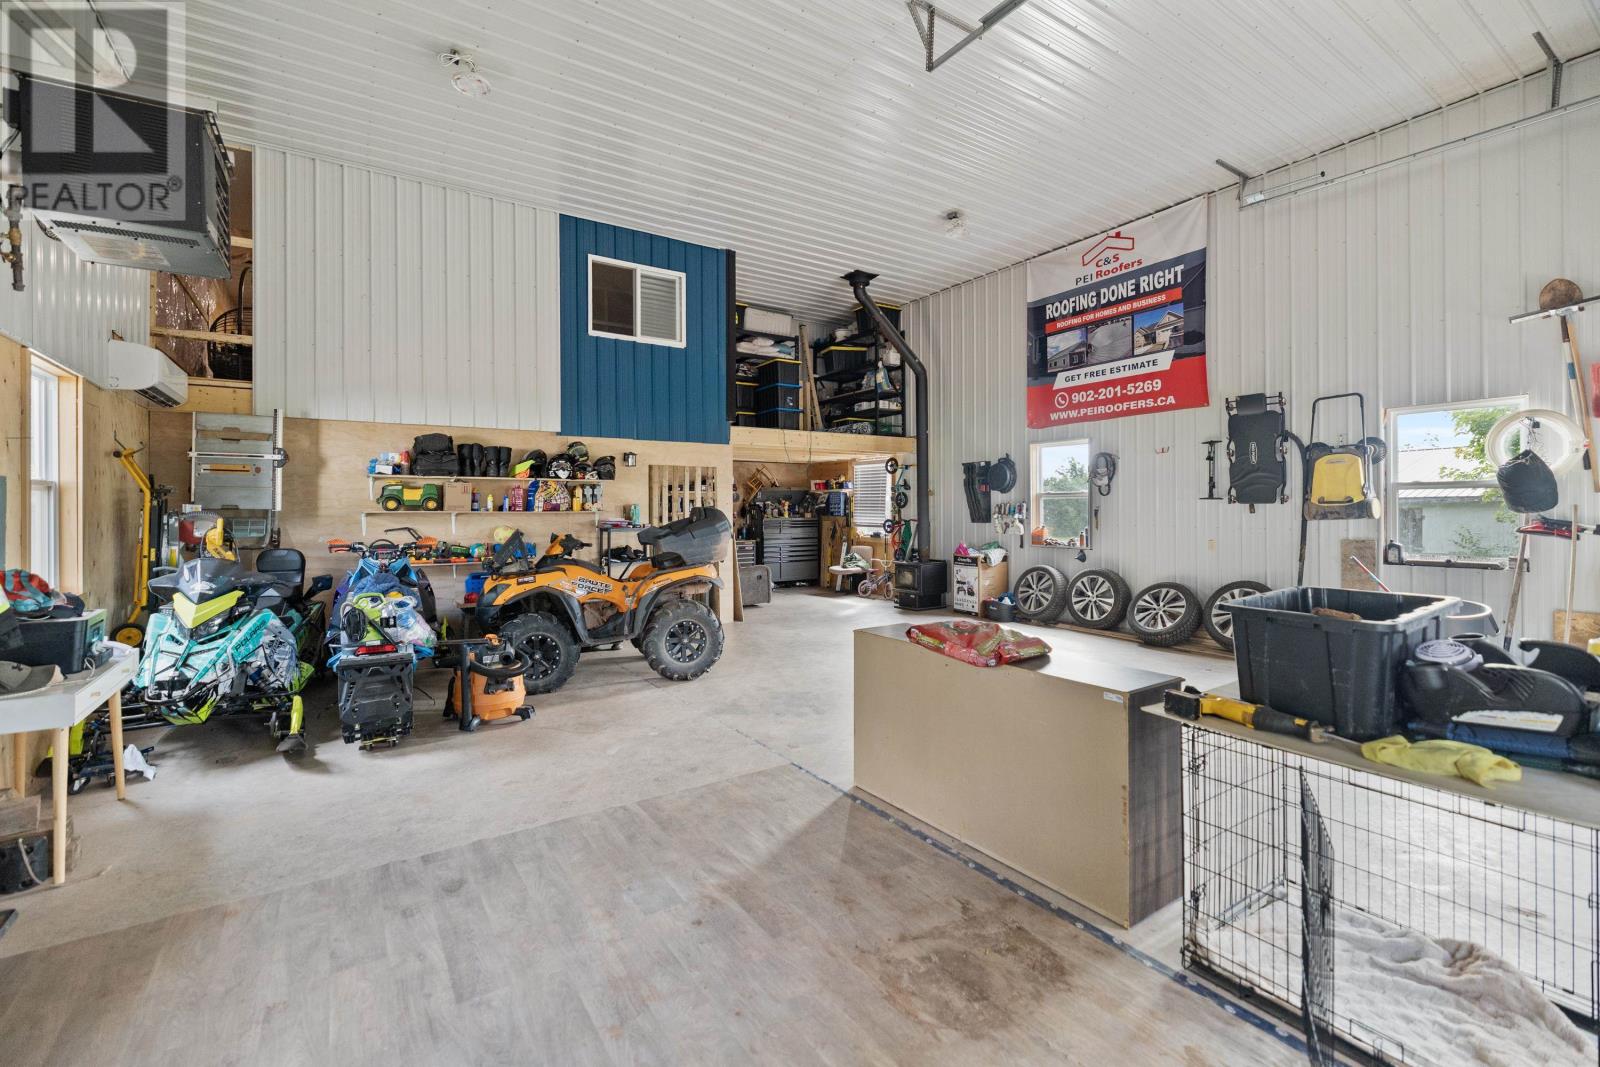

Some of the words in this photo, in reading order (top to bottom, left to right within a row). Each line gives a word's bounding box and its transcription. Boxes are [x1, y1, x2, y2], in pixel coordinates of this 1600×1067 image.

[1075, 273, 1093, 286] PEI
[1095, 258, 1143, 280] Roofers
[1095, 253, 1120, 268] C&S
[1045, 291, 1097, 320] ROOFING
[1100, 279, 1136, 305] DONE
[1139, 264, 1185, 293] RIGHT
[1056, 317, 1082, 329] ROOFING
[1082, 313, 1095, 323] FOR
[1095, 307, 1117, 320] HOMES
[1117, 303, 1132, 313] AND
[1132, 294, 1167, 308] BUSINESS
[1064, 373, 1082, 383] GET
[1084, 368, 1107, 379] FREE
[1109, 358, 1159, 375] ESTIMATE
[1071, 379, 1162, 404] 902-201-5269
[1050, 395, 1176, 421] WWW.PEIROOFERS.CA
